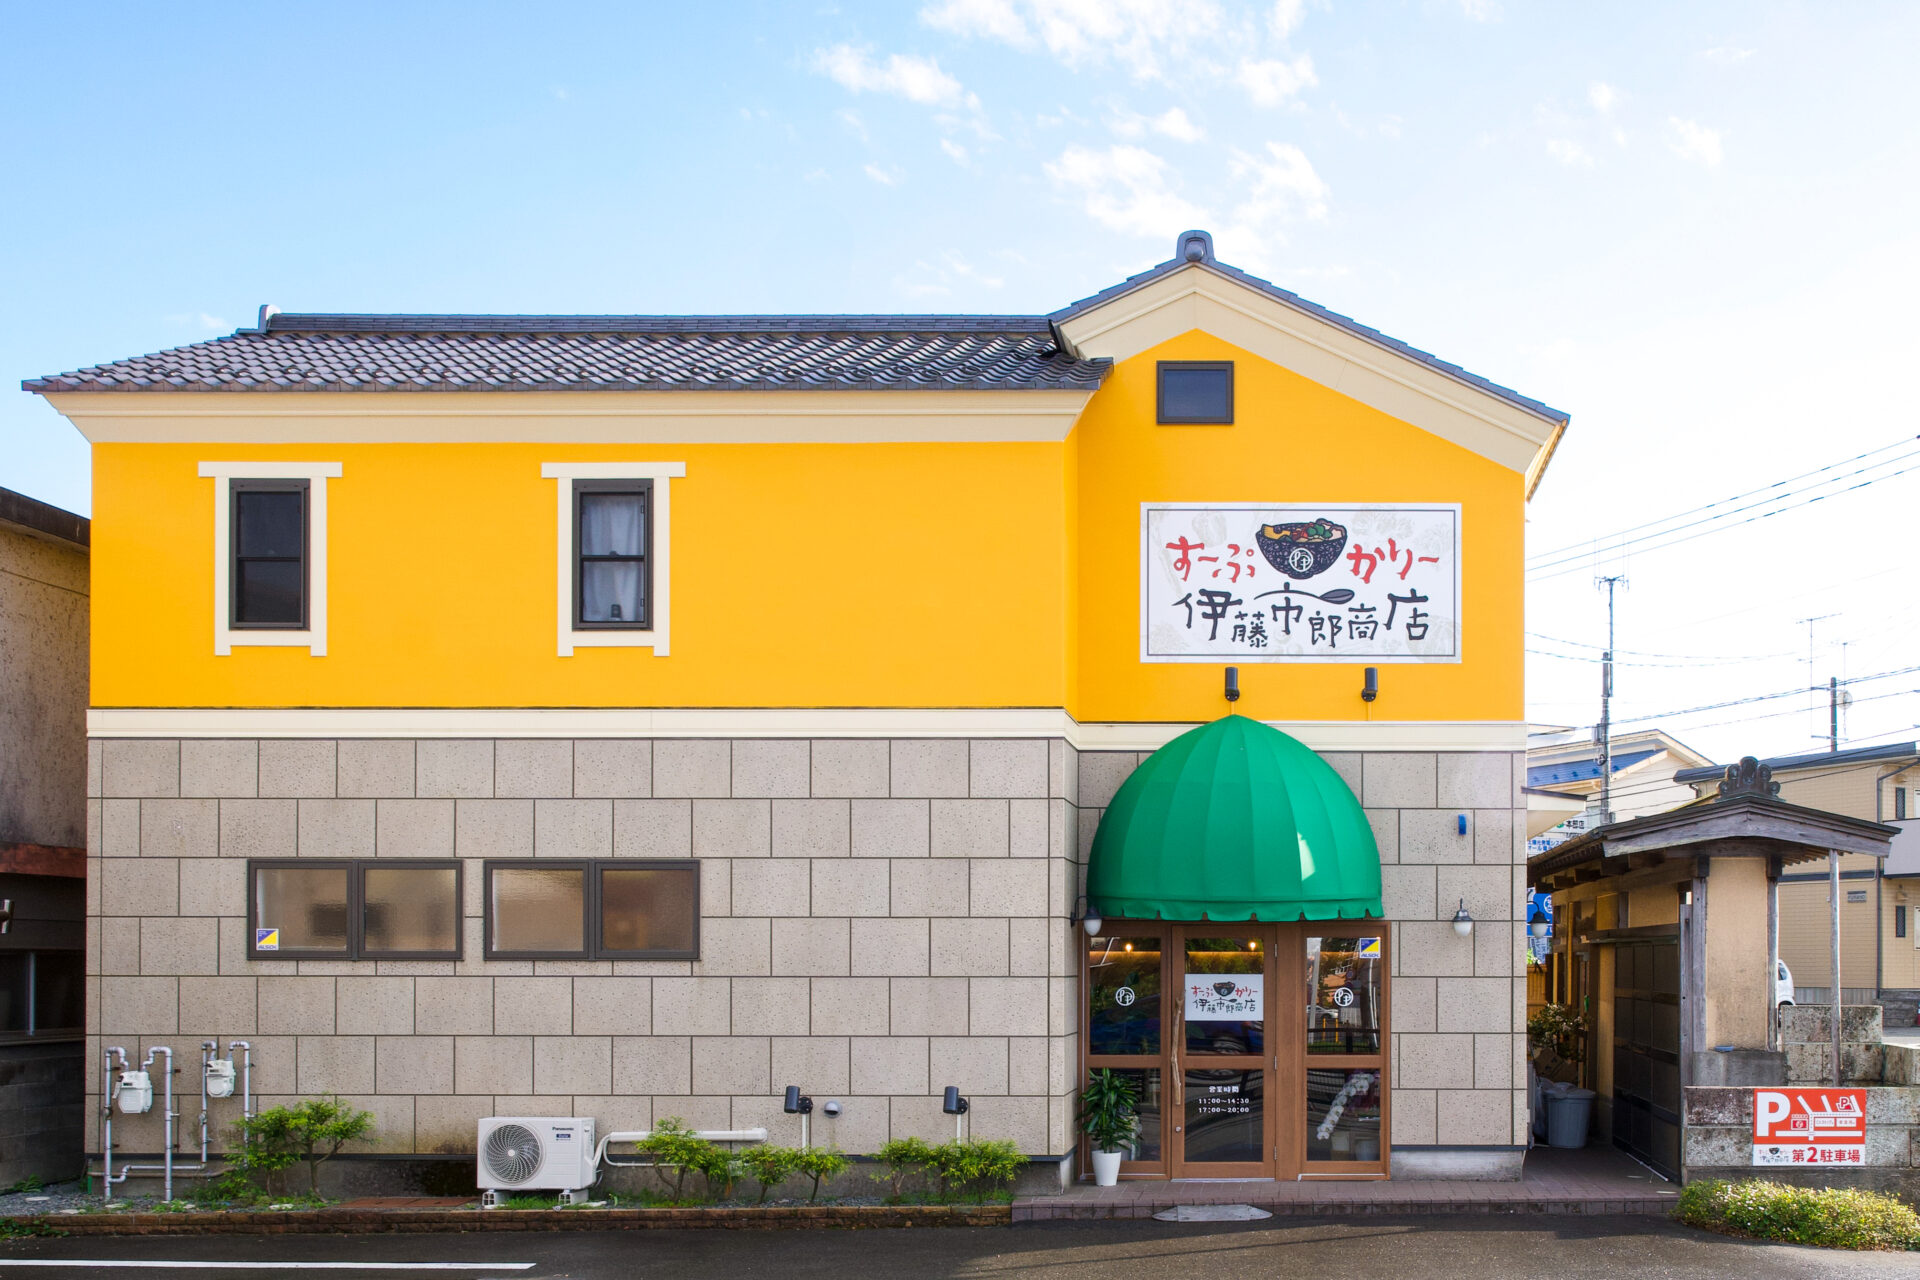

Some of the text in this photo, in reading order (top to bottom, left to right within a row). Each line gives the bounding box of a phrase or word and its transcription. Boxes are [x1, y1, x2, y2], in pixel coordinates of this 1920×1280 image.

[1165, 535, 1256, 583] すーぷ
[1346, 537, 1440, 584] かりー
[1171, 582, 1429, 648] 伊藤市郎商店
[1756, 1091, 1791, 1137] P
[1792, 1146, 1860, 1163] 第2駐車場
